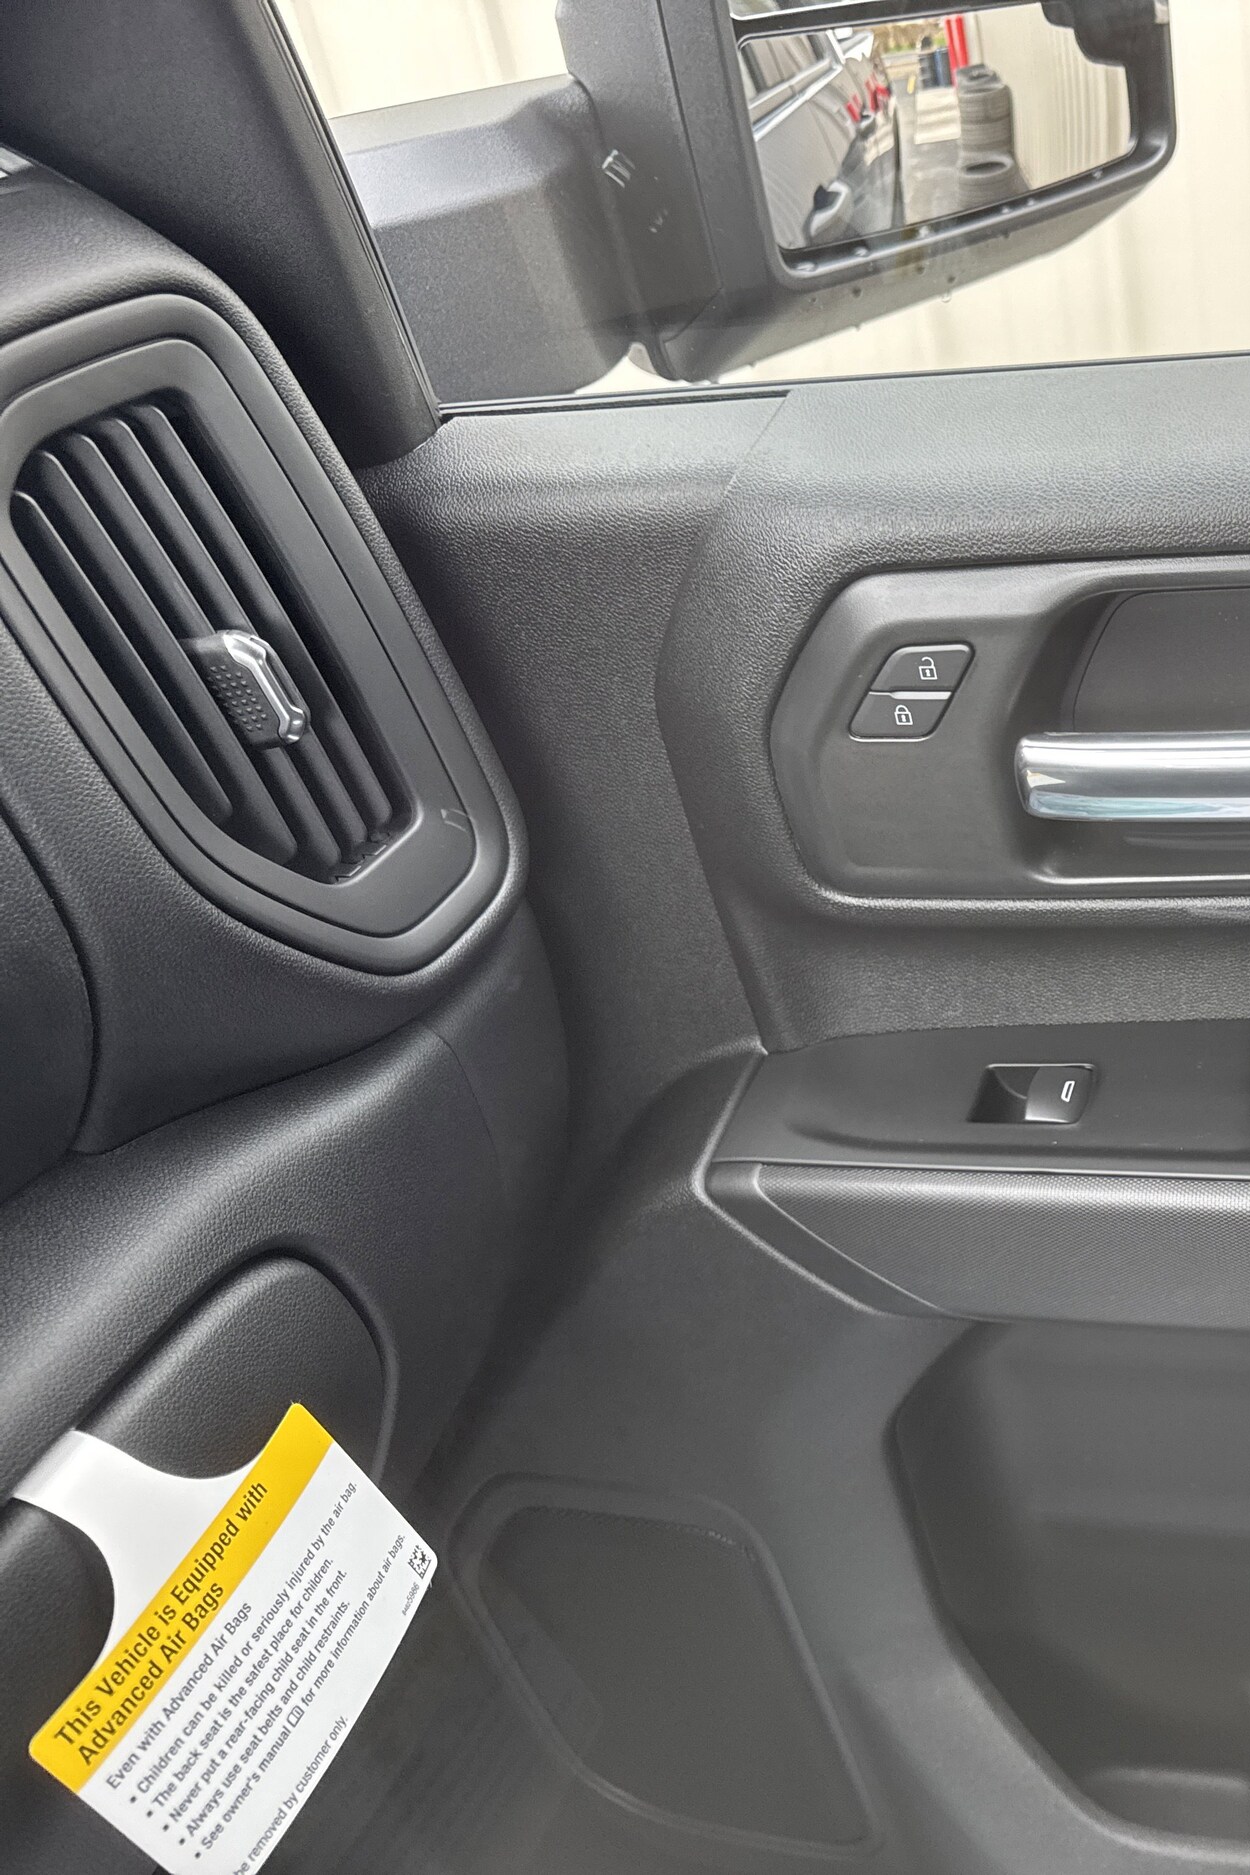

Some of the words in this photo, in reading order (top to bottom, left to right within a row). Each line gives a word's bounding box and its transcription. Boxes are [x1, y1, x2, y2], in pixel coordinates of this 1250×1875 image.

[54, 1700, 102, 1745] This
[95, 1626, 160, 1696] Vehicle
[154, 1605, 177, 1626] is
[170, 1518, 240, 1605] Equipped
[235, 1482, 268, 1522] with
[78, 1660, 164, 1766] Advanced
[159, 1630, 187, 1664] Air
[181, 1582, 224, 1632] Bags
[106, 1753, 140, 1790] Even
[137, 1719, 165, 1751] with
[162, 1653, 214, 1721] Advanced
[210, 1633, 228, 1657] Air
[224, 1602, 252, 1635] Bags
[137, 1737, 185, 1794] Children
[182, 1713, 205, 1737] can
[200, 1692, 217, 1711] be
[213, 1655, 243, 1693] killed
[241, 1640, 254, 1657] or
[251, 1588, 290, 1642] seriously
[285, 1548, 315, 1590] injured
[311, 1534, 325, 1551] by
[320, 1517, 336, 1537] the
[333, 1502, 344, 1519] air
[340, 1481, 357, 1503] bag.
[152, 1782, 177, 1808] The
[173, 1748, 203, 1782] back
[199, 1719, 224, 1750] seat
[220, 1707, 232, 1722] is
[227, 1686, 247, 1708] the
[245, 1648, 273, 1687] safest
[269, 1619, 294, 1652] place
[289, 1600, 304, 1619] for
[302, 1557, 334, 1602] children.
[169, 1782, 203, 1823] Never
[200, 1758, 221, 1785] put
[217, 1749, 228, 1760] a
[225, 1681, 276, 1750] rear-facing
[271, 1651, 294, 1683] child
[290, 1626, 311, 1654] seat
[305, 1616, 318, 1629] in
[314, 1596, 330, 1616] the
[325, 1570, 347, 1598] front.
[185, 1788, 225, 1837] Always
[222, 1763, 242, 1789] use
[240, 1734, 263, 1764] seat
[257, 1704, 283, 1736] belts
[280, 1679, 299, 1705] and
[295, 1650, 318, 1681] child
[314, 1601, 350, 1654] restraints.
[201, 1823, 225, 1850] See
[222, 1772, 261, 1823] owner's
[258, 1726, 292, 1773] manual
[301, 1687, 316, 1707] for
[313, 1659, 335, 1690] more
[330, 1600, 370, 1660] information
[366, 1570, 386, 1601] about
[382, 1557, 393, 1573] air
[388, 1534, 406, 1559] bags.
[248, 1807, 287, 1862] removed
[283, 1792, 299, 1810] by
[295, 1740, 332, 1794] customer
[329, 1715, 349, 1742] only.
